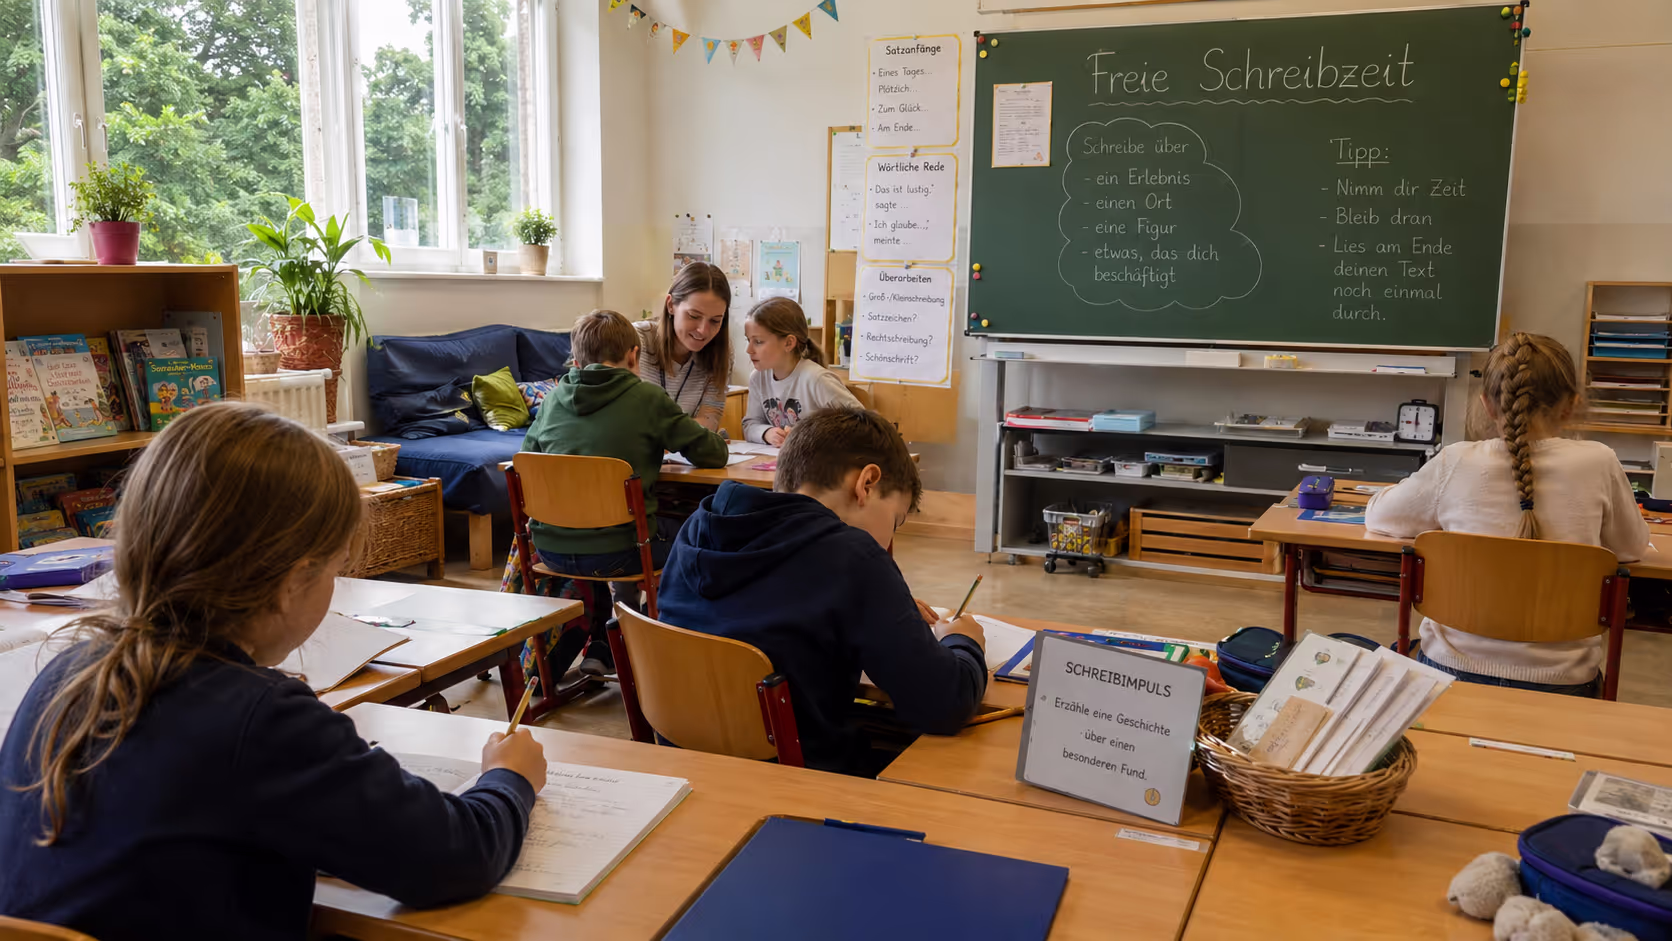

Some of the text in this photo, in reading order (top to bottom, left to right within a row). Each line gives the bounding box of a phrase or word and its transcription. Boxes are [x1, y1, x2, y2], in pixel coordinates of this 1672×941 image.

[886, 44, 941, 56] Satzanfänge
[878, 68, 898, 77] Eines
[1087, 43, 1414, 94] Freie Schreibzeit
[878, 105, 895, 113] Zum
[878, 124, 890, 132] Am
[1083, 137, 1189, 154] Schreibe über
[1330, 138, 1390, 168] Tipp:
[878, 162, 944, 171] Wörtliche Rede
[1096, 168, 1190, 185] ein Erlebnis
[875, 185, 889, 193] Das
[893, 185, 902, 193] ist
[1336, 178, 1466, 196] Nimm dir Zeit
[876, 201, 897, 212] sagte
[1096, 193, 1172, 209] einen Ort
[874, 220, 887, 228] Ich
[1336, 207, 1432, 225] Bleib dran
[1095, 218, 1177, 240] eine Figur
[1094, 242, 1219, 262] etwas, das dich
[1334, 235, 1453, 255] Lies am Ende
[880, 271, 931, 283] Überarbeiten
[1094, 265, 1176, 288] beschäftigt
[1334, 260, 1435, 278] deinen Text
[1333, 282, 1442, 299] noch einmal
[1332, 304, 1386, 320] durch.
[867, 332, 933, 347] Rechtschreibung?
[1065, 662, 1171, 698] SCHREIBIMPULS
[1055, 697, 1170, 736] Erzähle eine Geschichte
[1085, 729, 1135, 752] über einen
[1063, 748, 1148, 781] besonderen Fund.
